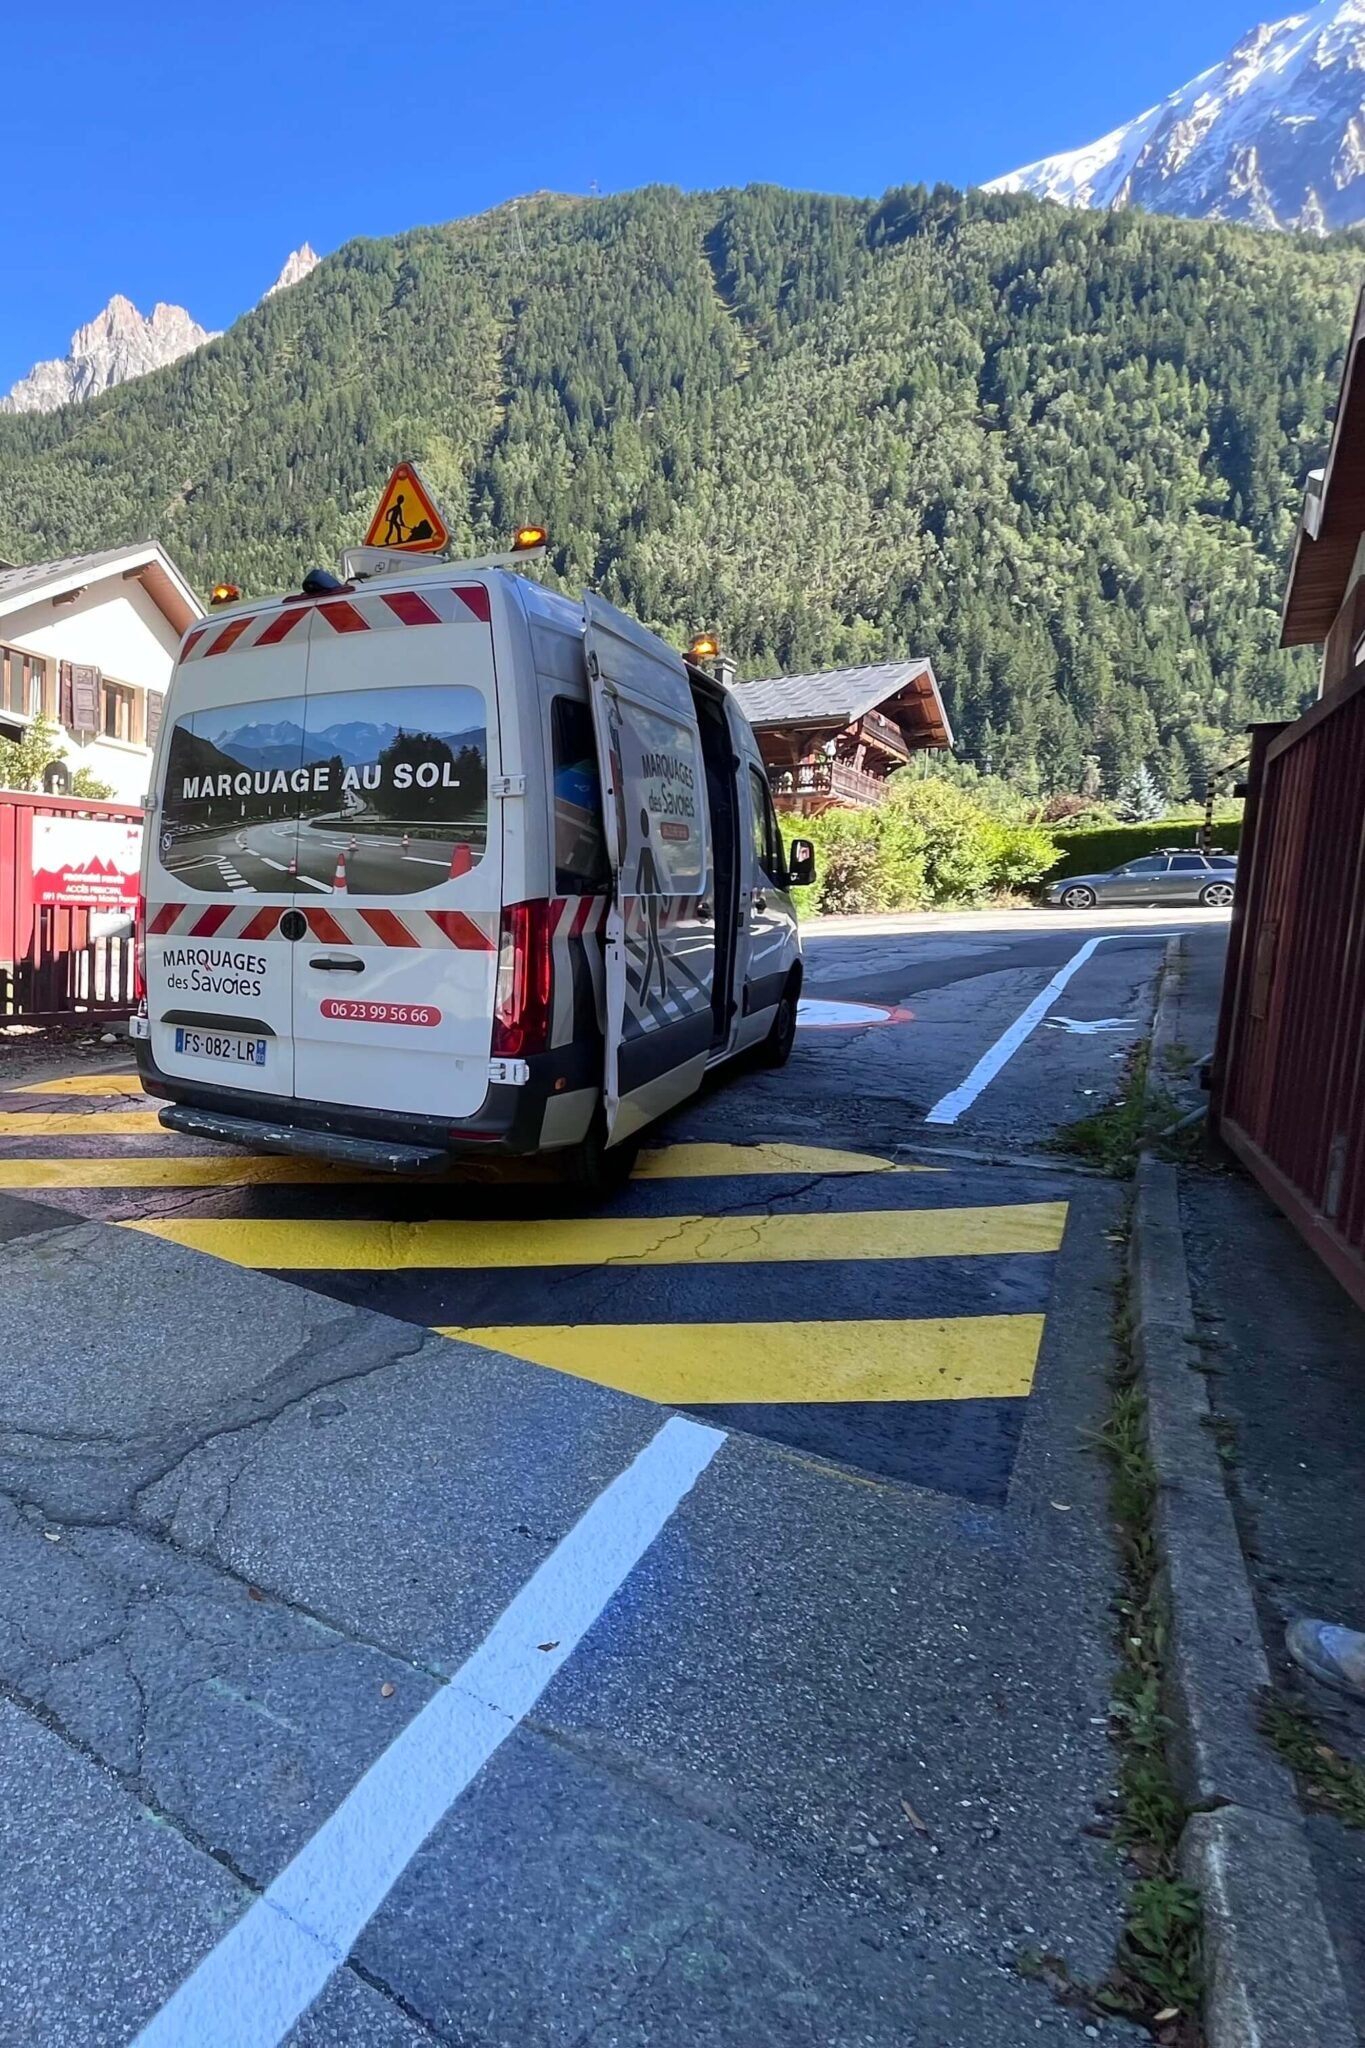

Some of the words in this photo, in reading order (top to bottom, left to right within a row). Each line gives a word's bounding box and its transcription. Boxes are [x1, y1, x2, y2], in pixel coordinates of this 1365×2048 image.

[183, 768, 330, 799] MARQUAGE
[341, 765, 382, 790] AU
[393, 762, 461, 788] SOL
[642, 754, 694, 789] MARQUAGES
[649, 789, 661, 811] des
[661, 782, 695, 817] Savoies
[163, 949, 267, 975] MARQUAGES
[167, 973, 189, 990] des
[191, 969, 261, 997] Savoies
[331, 1002, 347, 1016] 06
[350, 1004, 366, 1018] 23
[370, 1005, 387, 1020] 99
[390, 1007, 407, 1021] 56
[410, 1009, 428, 1023] 66
[184, 1032, 255, 1062] FS-082-LR
